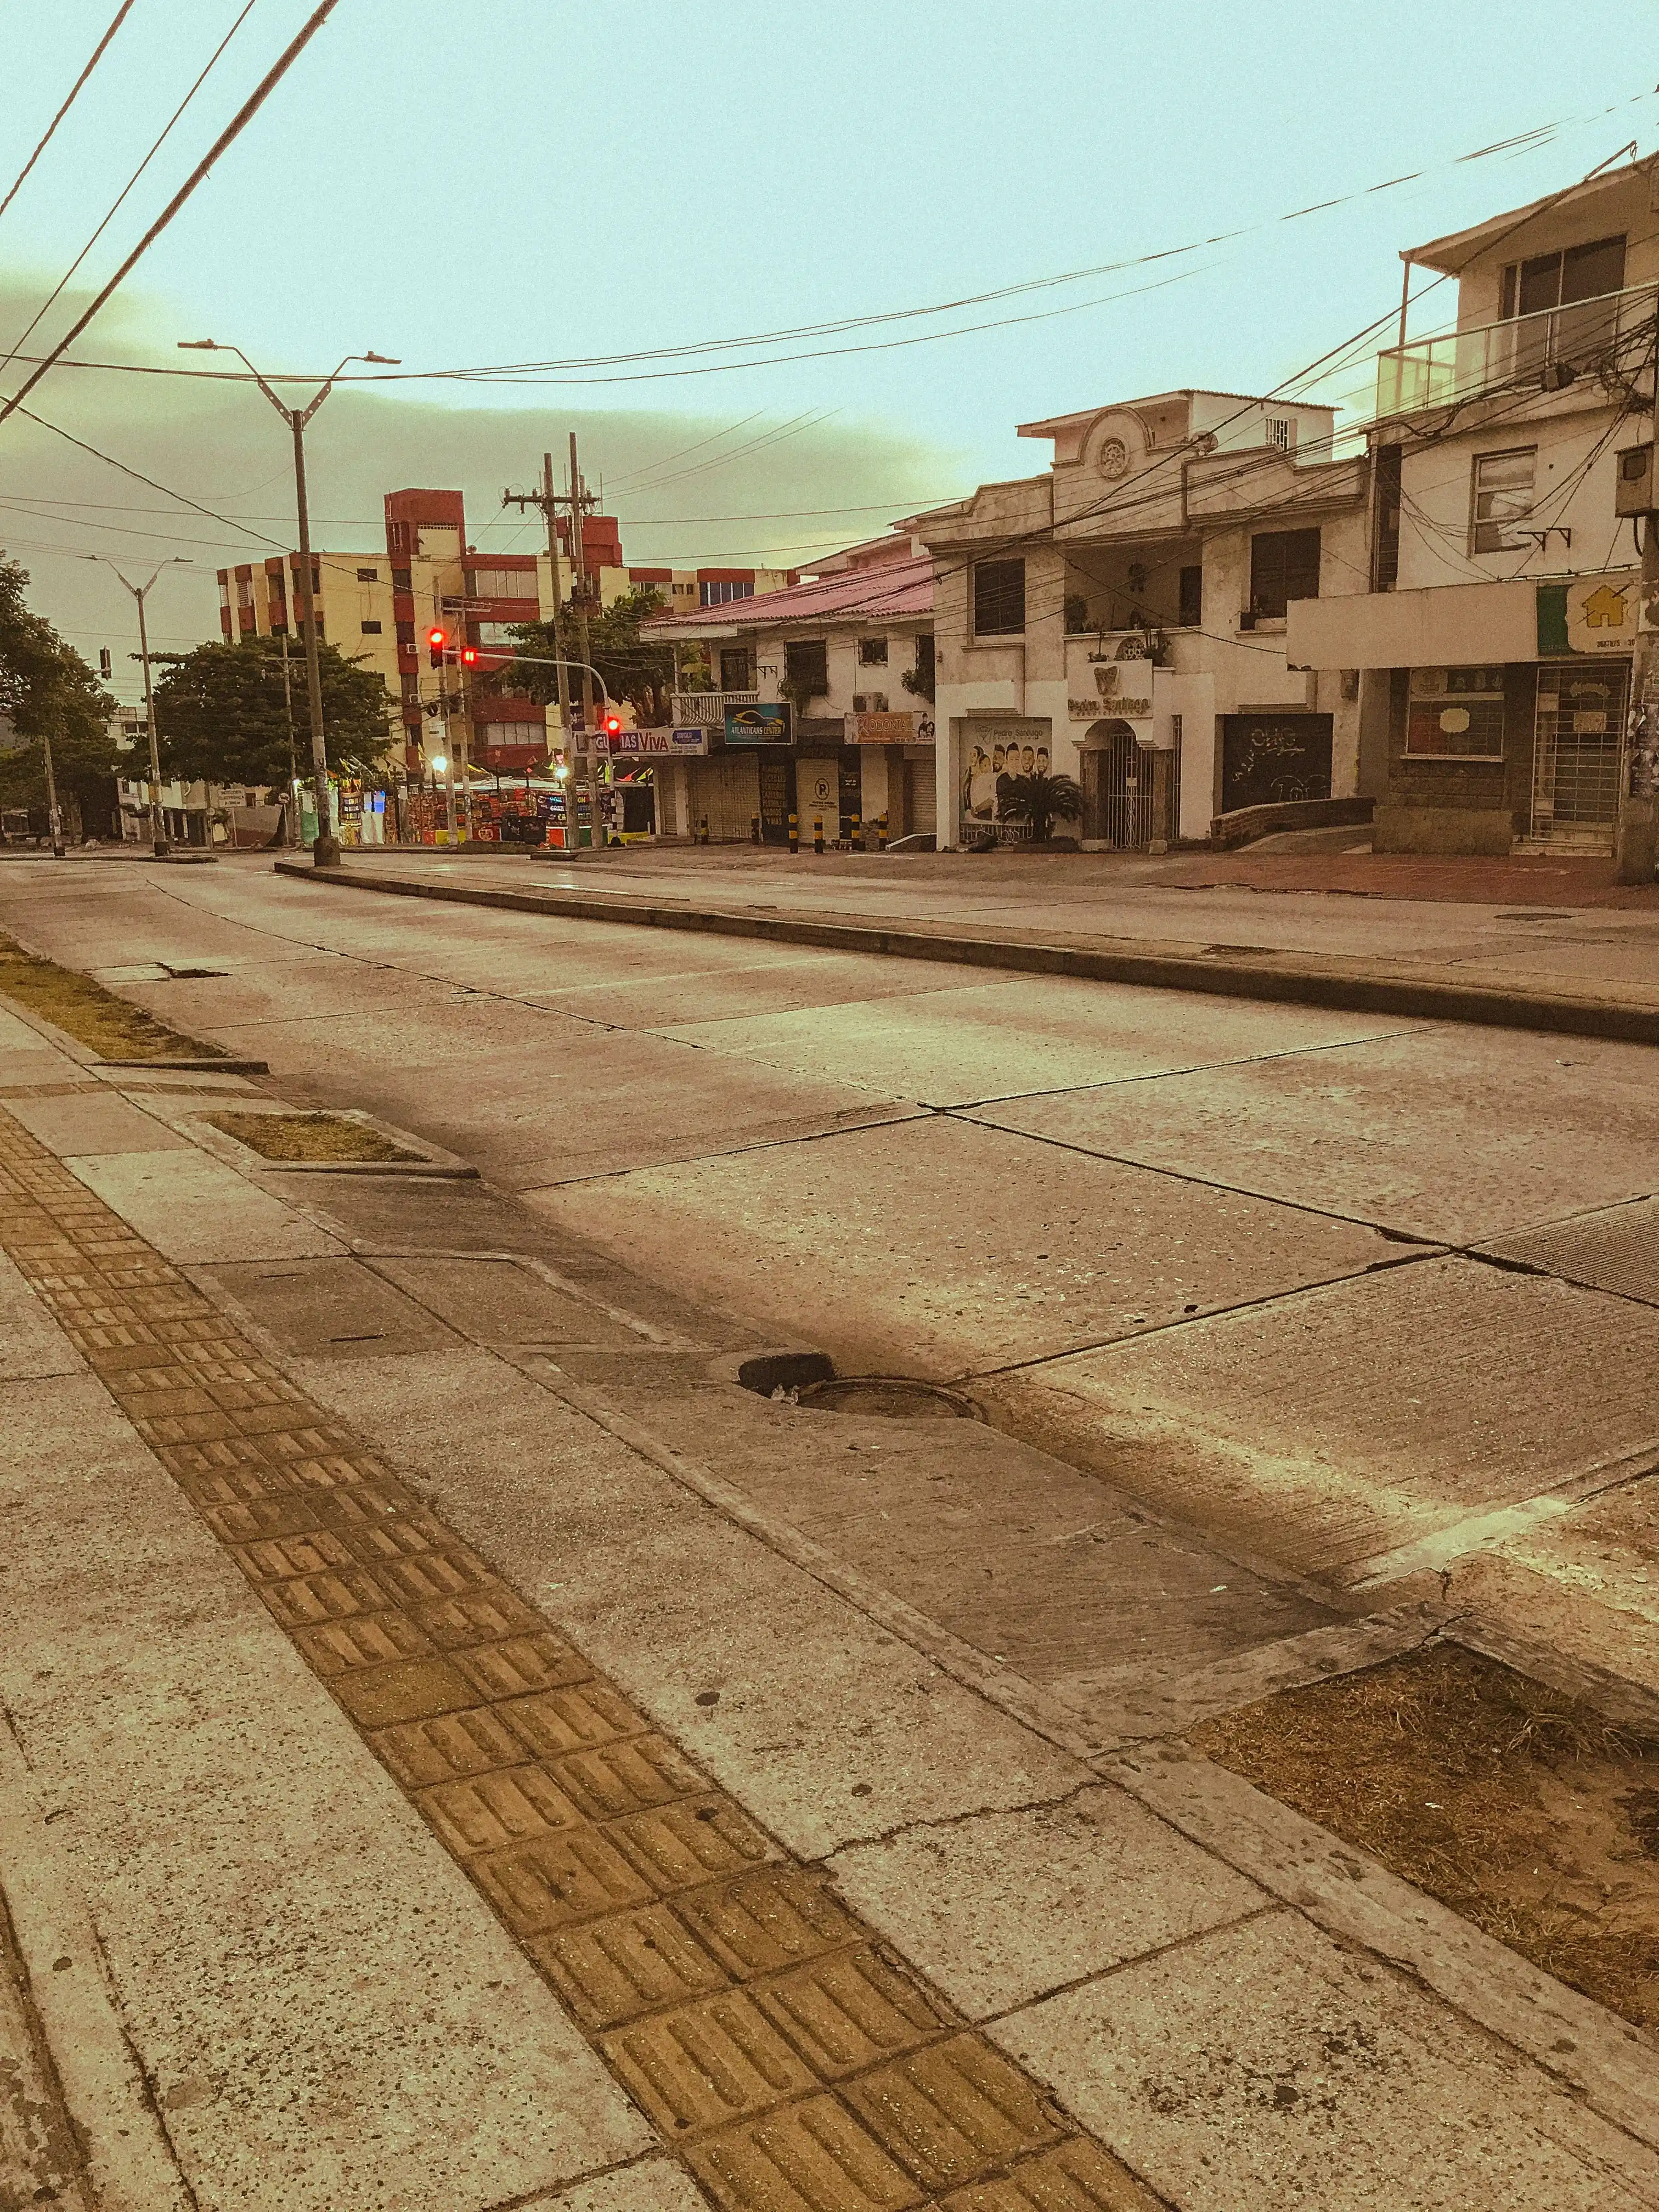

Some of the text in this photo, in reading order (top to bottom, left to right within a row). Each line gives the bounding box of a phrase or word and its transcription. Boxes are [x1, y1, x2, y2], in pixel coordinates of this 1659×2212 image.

[1068, 697, 1150, 714] Pedro Santiago
[763, 726, 782, 735] CENTER
[1015, 729, 1043, 739] Santiago
